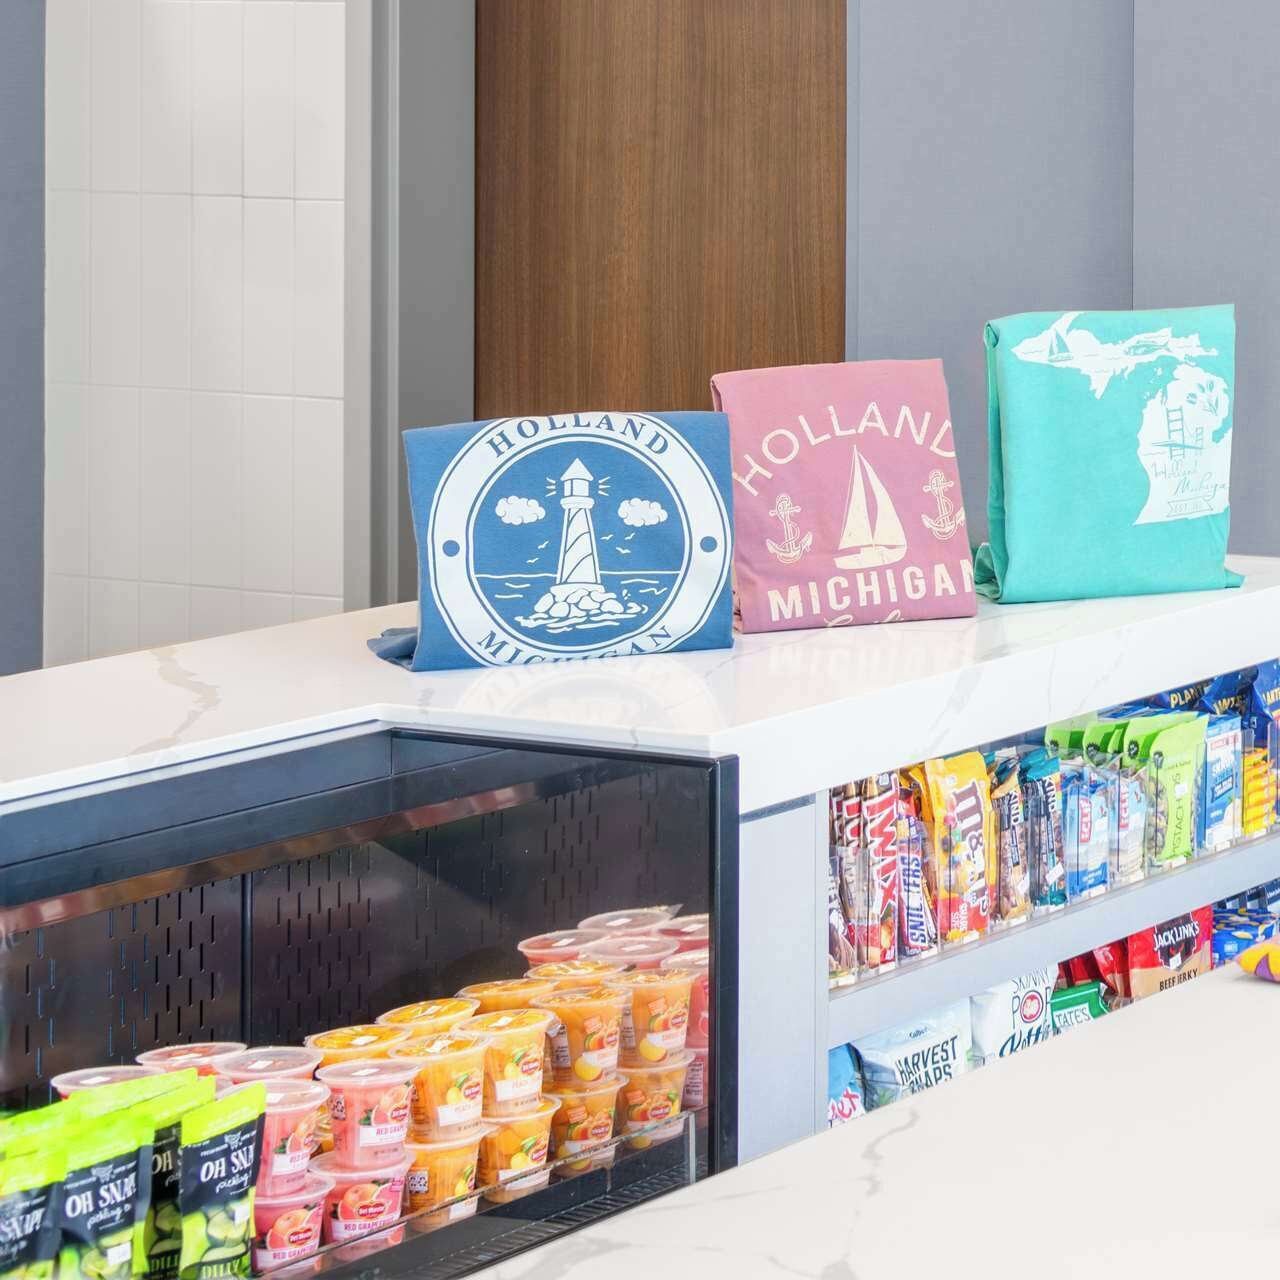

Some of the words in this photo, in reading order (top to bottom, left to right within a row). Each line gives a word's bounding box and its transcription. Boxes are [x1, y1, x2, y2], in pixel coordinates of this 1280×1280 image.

[486, 414, 670, 458] HOLLAND
[735, 402, 957, 497] HOLLAND
[1044, 776, 1056, 812] KIND
[1008, 791, 1020, 825] KIND
[862, 773, 900, 918] TWIX
[1154, 929, 1175, 951] JACK
[1175, 920, 1200, 941] LINK'S
[1159, 976, 1175, 991] BEEF
[1177, 968, 1198, 985] JERKY
[1055, 1006, 1090, 1029] TATE'S
[895, 1035, 958, 1085] HARVEST
[376, 1127, 388, 1136] RED
[152, 1153, 172, 1176] OH
[200, 1162, 226, 1184] OH
[65, 1193, 94, 1218] OH
[344, 1222, 357, 1231] RED
[272, 1251, 286, 1260] RED
[201, 1259, 239, 1280] DILLY
